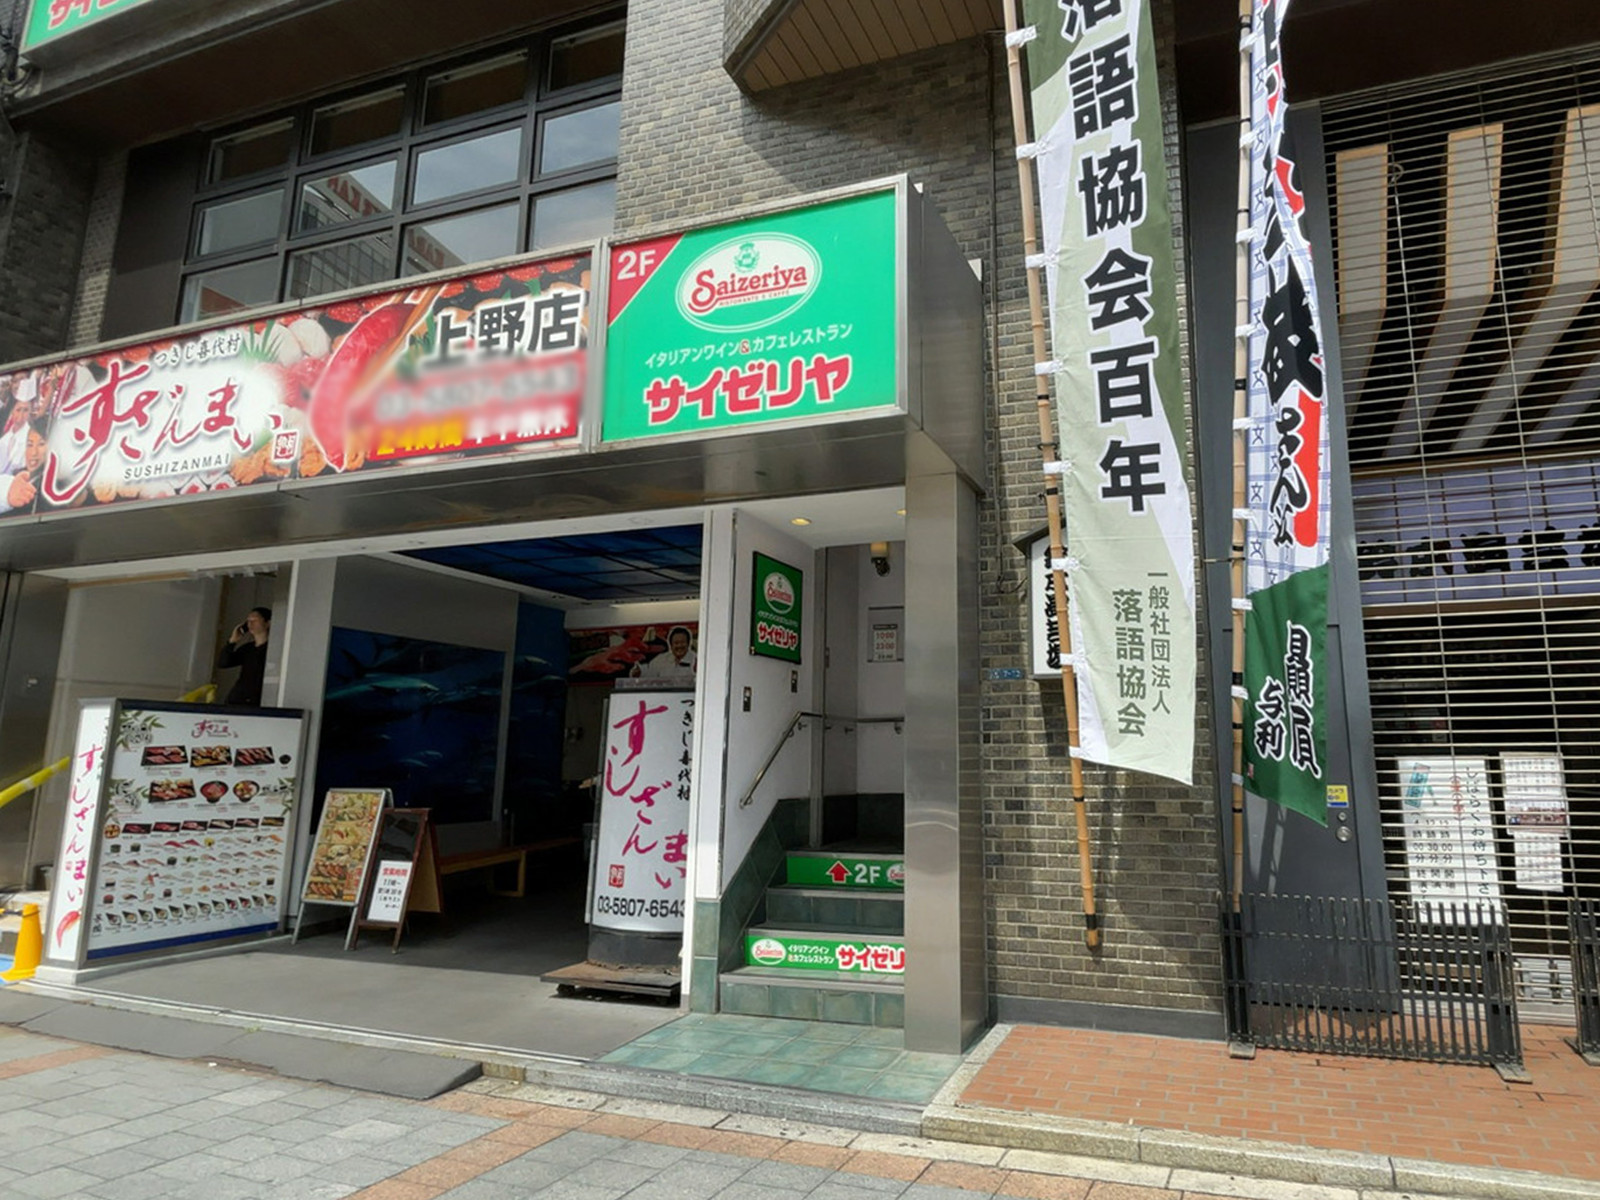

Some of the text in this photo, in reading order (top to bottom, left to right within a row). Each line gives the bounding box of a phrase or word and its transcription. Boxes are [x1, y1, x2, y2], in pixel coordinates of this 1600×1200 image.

[617, 250, 656, 280] 2F
[691, 265, 806, 308] Saizeriya
[432, 292, 583, 362] 上野店
[644, 354, 851, 425] サイゼリヤ
[43, 361, 281, 501] すしざんまい
[123, 454, 230, 479] SUSHIZANMAI
[1112, 588, 1147, 738] 落語協会
[1147, 571, 1172, 716] 一般社団法人
[605, 700, 688, 889] すしざんまい
[855, 863, 881, 883] 2F
[836, 945, 905, 971] サイゼリ
